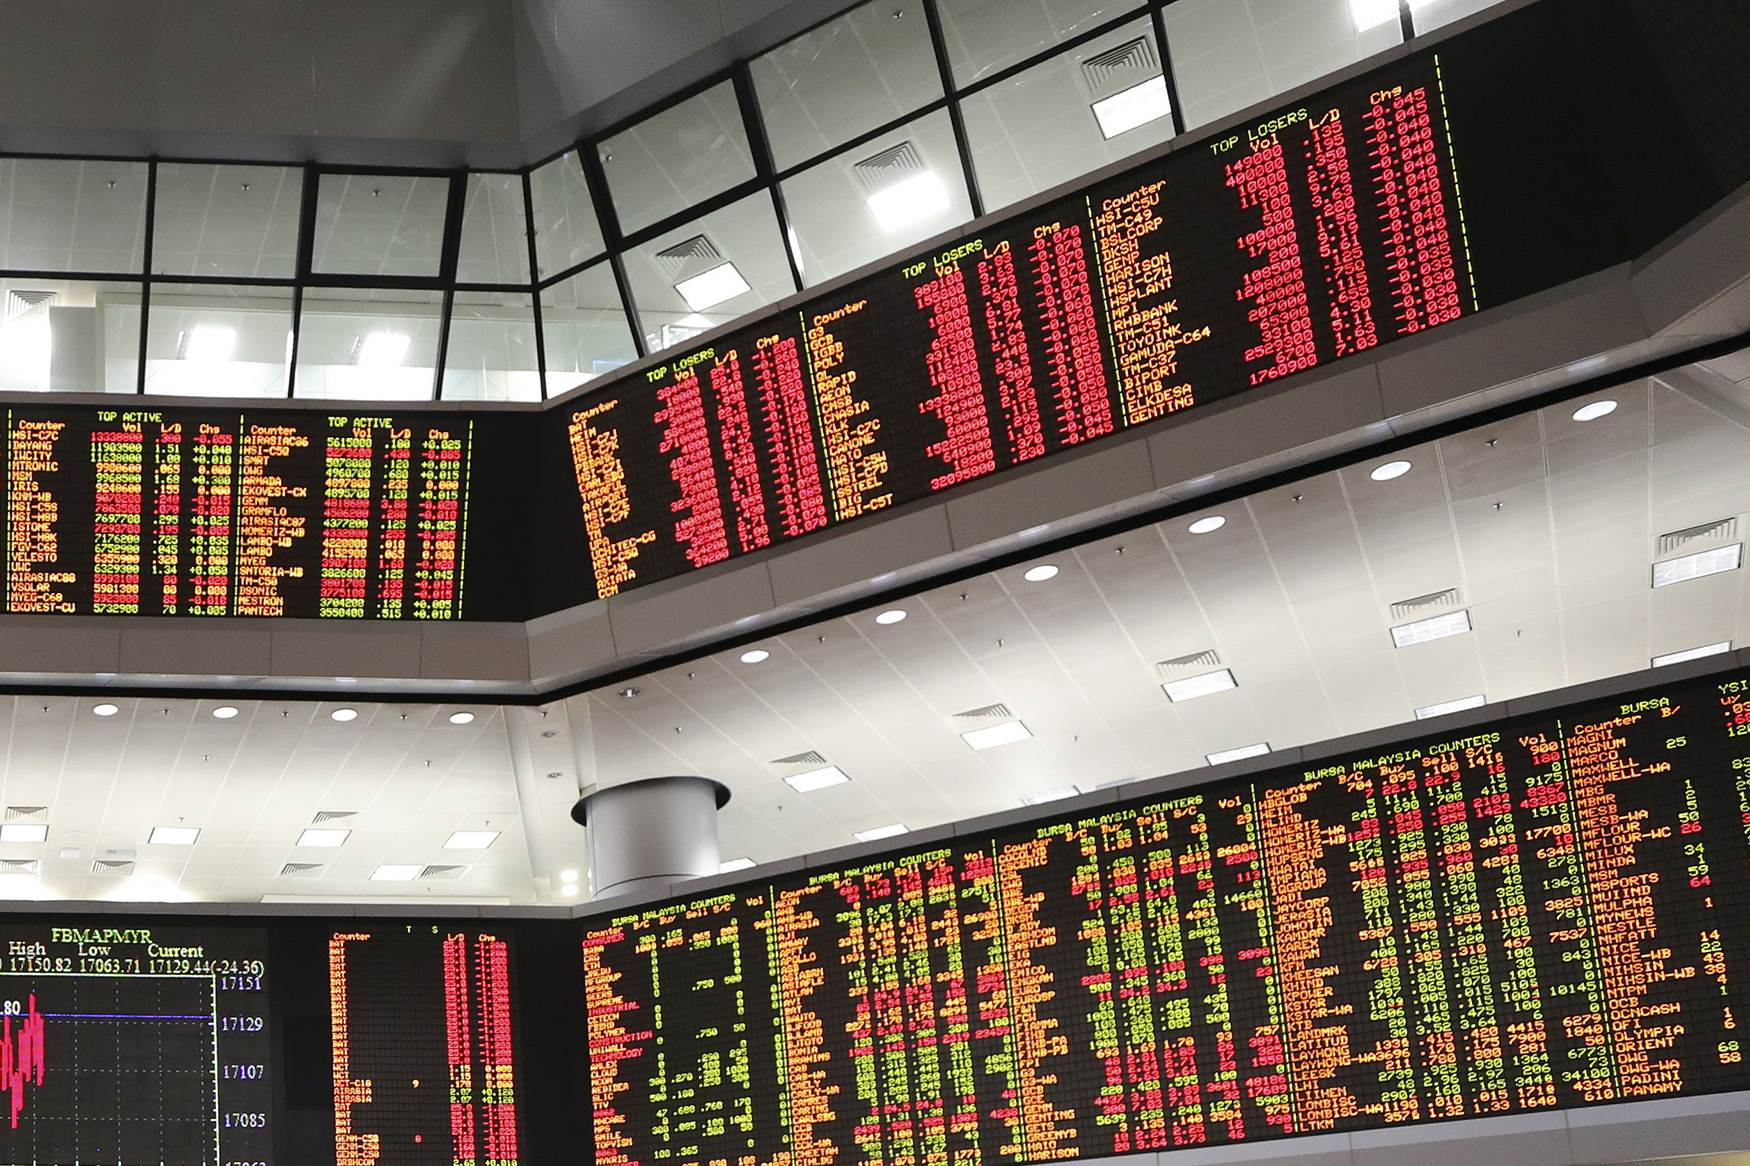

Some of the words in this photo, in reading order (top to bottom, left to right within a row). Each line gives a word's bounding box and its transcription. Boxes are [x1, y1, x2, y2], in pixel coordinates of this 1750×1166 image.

[1210, 136, 1239, 156] TOP
[1247, 108, 1309, 142] LOSERS
[1102, 180, 1166, 210] Counter
[1113, 300, 1178, 331] RHBBANK
[1118, 323, 1181, 353] TOYOINK
[646, 366, 668, 383] TOP
[672, 347, 716, 374] LOSERS
[1130, 396, 1194, 424] GENTING
[1250, 354, 1318, 385] 1760900
[1335, 333, 1378, 357] 7.03
[1397, 306, 1461, 334] -0.030
[1125, 380, 1162, 401] CIMB
[1127, 383, 1192, 413] ELKDESA
[243, 476, 282, 486] ARMADA
[12, 552, 57, 563] VELESTO
[240, 546, 273, 557] LAMBO
[596, 569, 636, 589] AXIATA
[598, 585, 619, 599] CCM
[238, 605, 283, 617] PANTECH
[1566, 730, 1613, 747] MAGNI
[1568, 739, 1626, 756] MAGNUM
[1304, 764, 1345, 781] BURSA
[1353, 749, 1421, 772] MALAYSIA
[1429, 733, 1500, 756] COUNTERS
[1570, 751, 1619, 768] MARCO
[1590, 873, 1659, 892] MSPORTS
[406, 925, 412, 934] T
[432, 926, 438, 934] S
[777, 918, 820, 933] AIRASIA
[1597, 916, 1656, 934] NESTLE
[51, 928, 151, 944] FBMAPMYR
[333, 932, 371, 941] Counter
[9, 942, 46, 958] High
[78, 942, 111, 957] Low
[147, 943, 204, 958] Current
[1277, 940, 1319, 954] KAREX
[10, 958, 72, 972] 17150.82
[79, 958, 141, 973] 17063.71
[221, 976, 262, 990] 17151
[222, 1018, 263, 1031] 17129
[1290, 1036, 1349, 1050] LATITUD
[223, 1065, 264, 1079] 17107
[1621, 1070, 1680, 1086] PADINI
[412, 1080, 420, 1088] 9
[1623, 1081, 1683, 1098] PANAMY
[450, 1088, 472, 1096] 2.07
[224, 1114, 265, 1128] 17085
[1024, 1110, 1076, 1123] GENTING
[453, 1159, 475, 1166] 2.65
